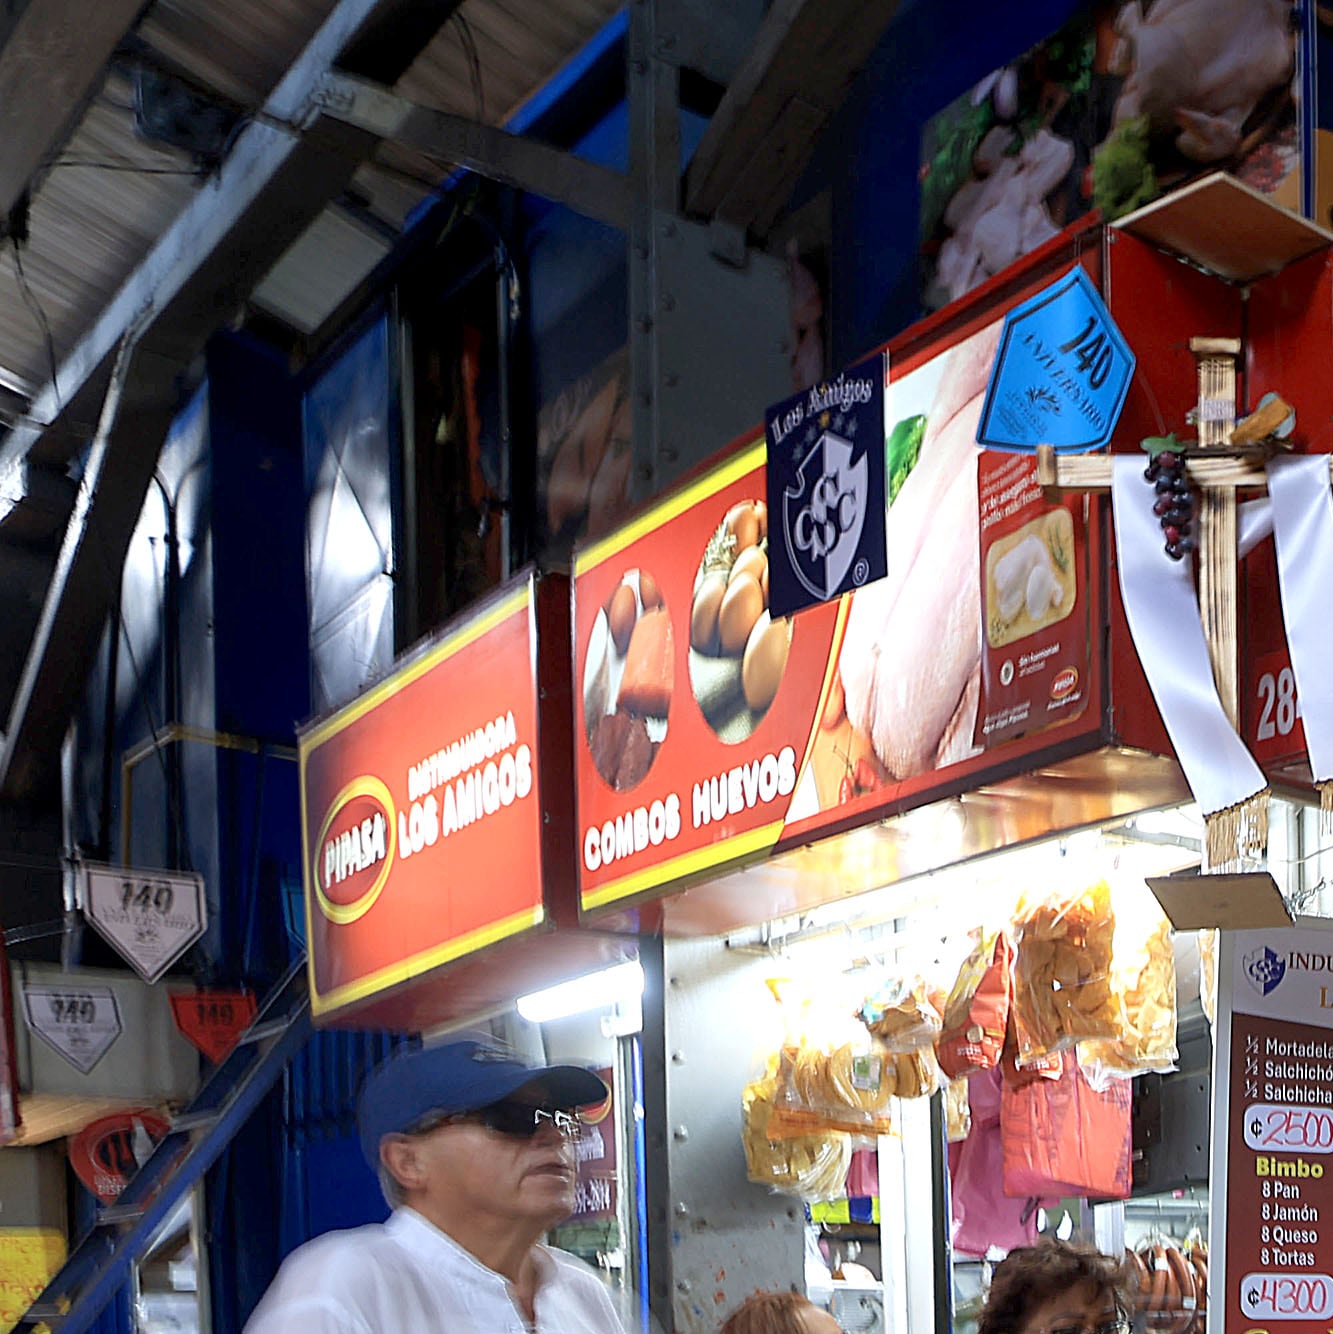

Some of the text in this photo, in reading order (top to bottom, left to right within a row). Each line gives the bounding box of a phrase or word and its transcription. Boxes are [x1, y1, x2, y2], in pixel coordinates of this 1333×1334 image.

[1059, 316, 1113, 390] 140
[770, 410, 803, 445] Los
[1257, 666, 1295, 742] 28
[398, 744, 532, 859] LOS AMIGOS
[584, 746, 796, 871] COMBOS HUEVOS
[324, 812, 386, 889] PIPASA
[121, 882, 174, 915] 140
[1256, 1156, 1324, 1179] Bimbo
[1262, 1181, 1300, 1199] 8 Pan
[1261, 1203, 1318, 1222] 8 Jamón
[1261, 1225, 1318, 1246] 8 Queso
[1260, 1248, 1315, 1266] 8 Tortas
